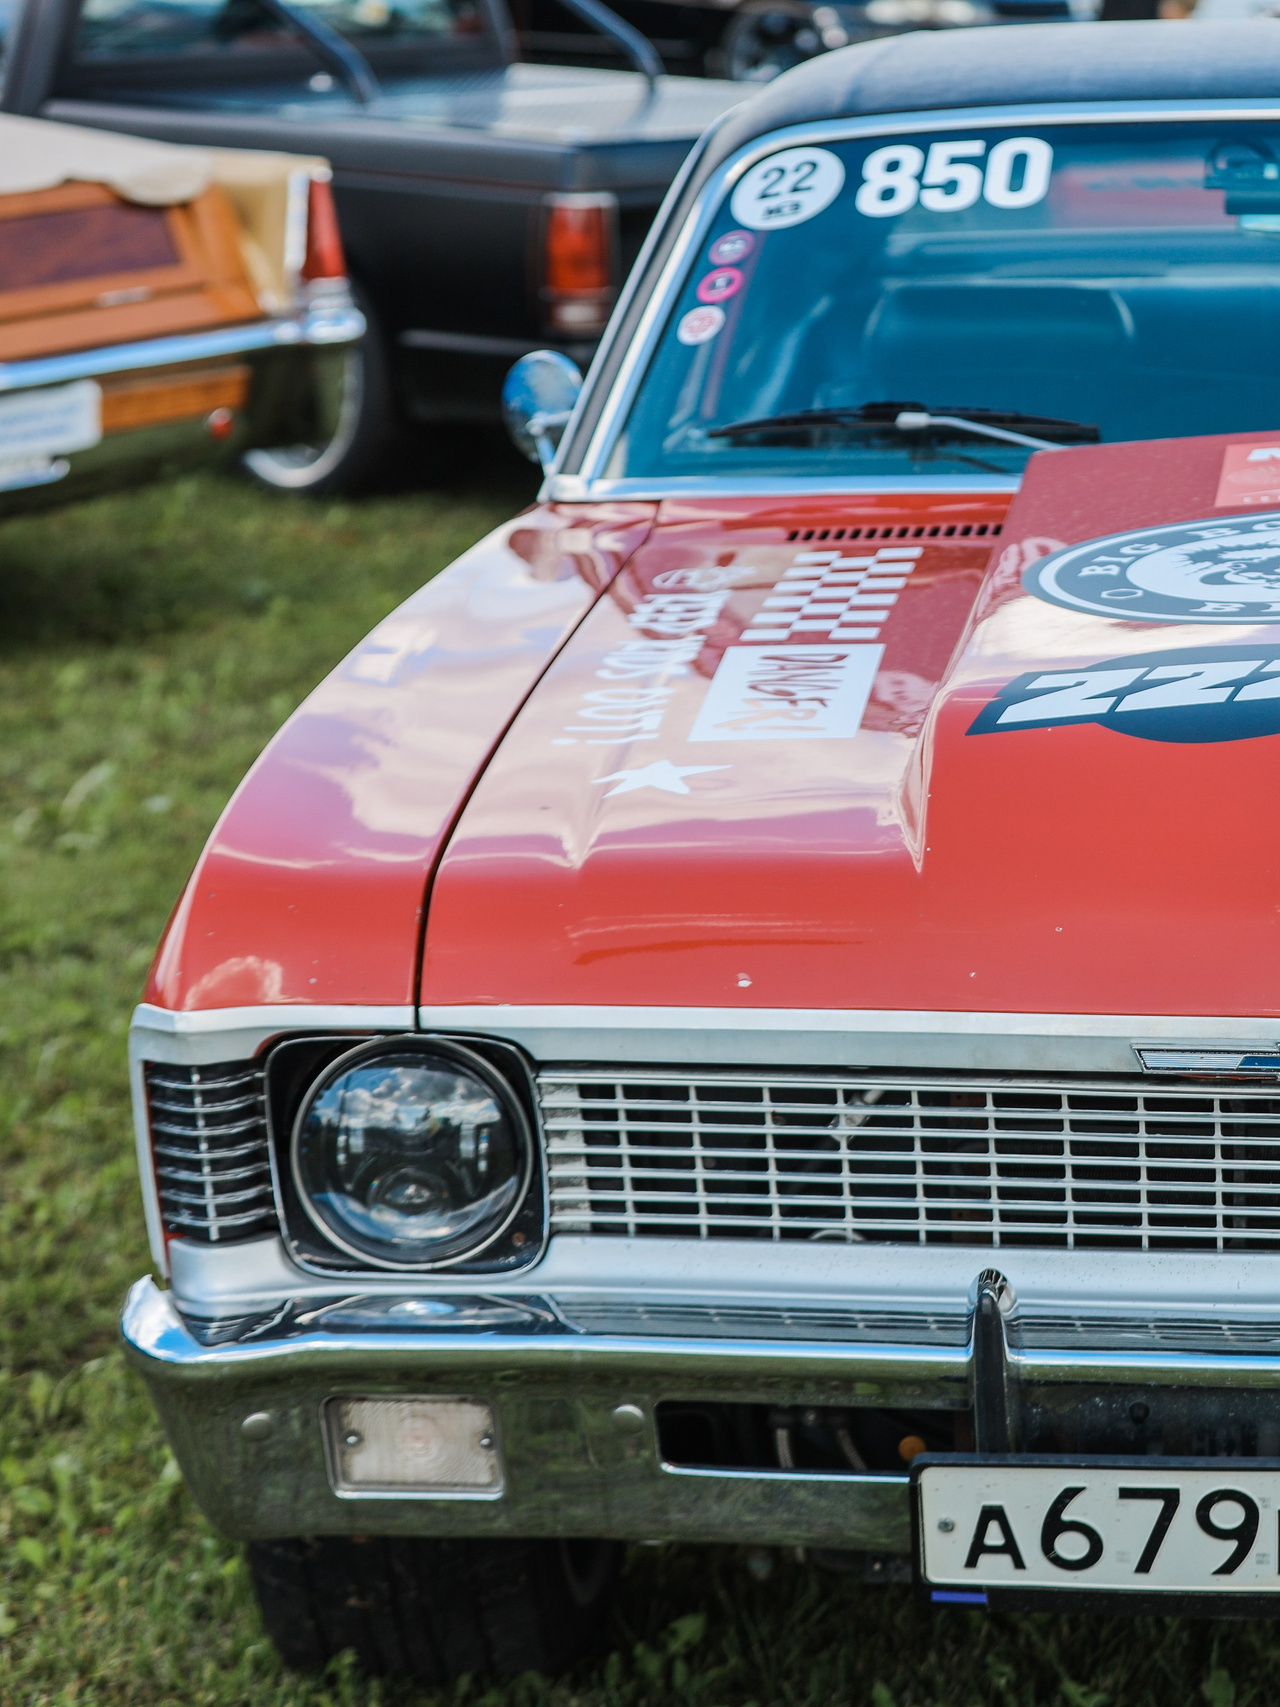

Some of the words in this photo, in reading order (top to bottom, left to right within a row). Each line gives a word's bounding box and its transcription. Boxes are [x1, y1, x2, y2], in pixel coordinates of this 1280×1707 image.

[757, 160, 818, 199] 22
[855, 136, 1054, 218] 850
[1076, 542, 1167, 577] BIG
[628, 589, 733, 637] KEEP
[595, 634, 707, 680] KIDS
[550, 686, 675, 745] OUT!
[711, 652, 851, 732] DANGER!
